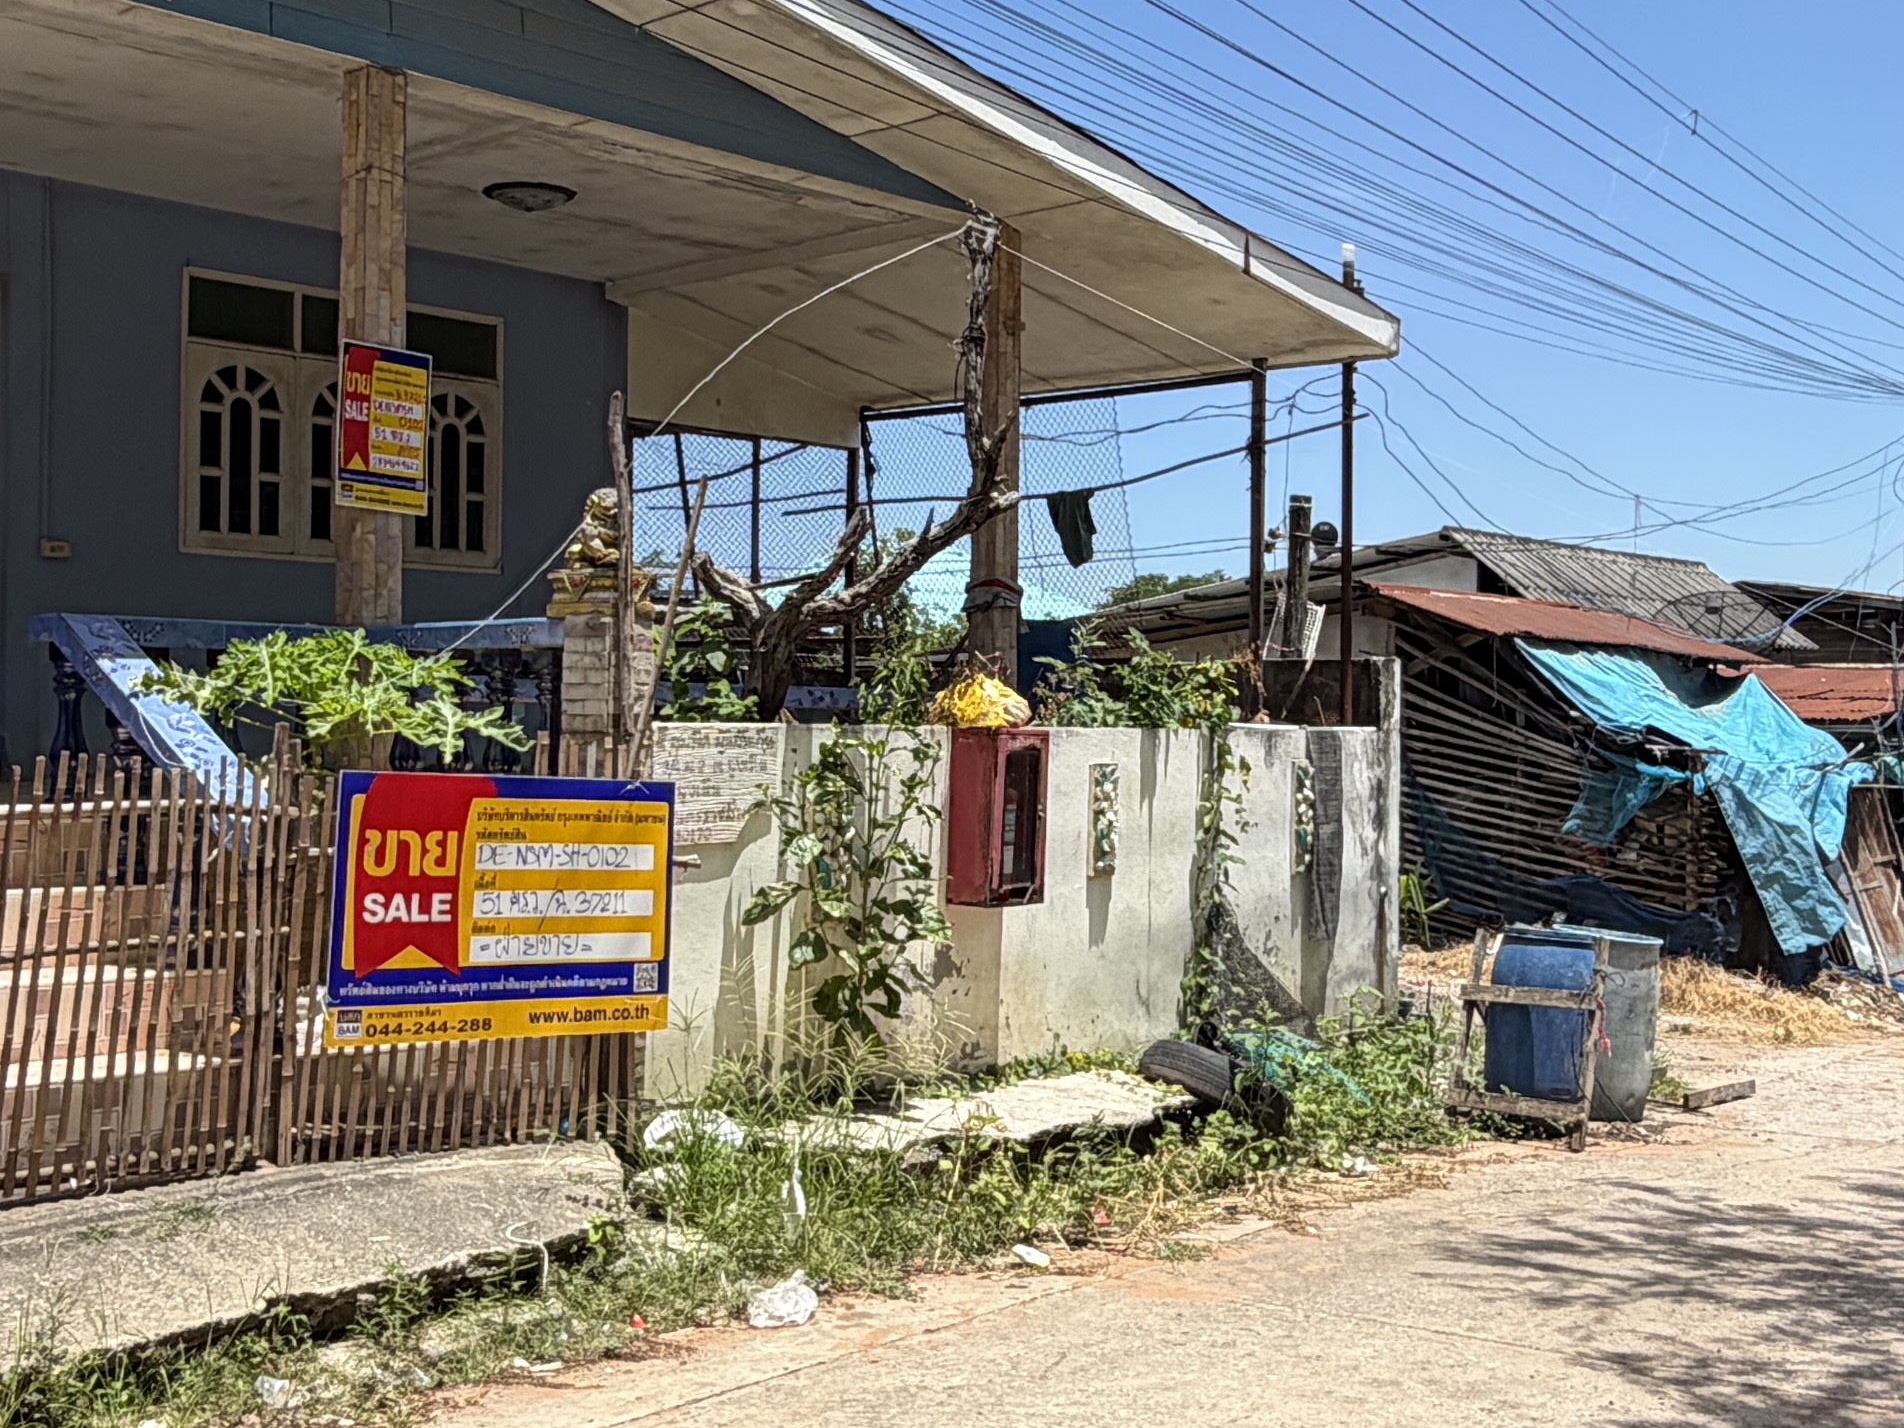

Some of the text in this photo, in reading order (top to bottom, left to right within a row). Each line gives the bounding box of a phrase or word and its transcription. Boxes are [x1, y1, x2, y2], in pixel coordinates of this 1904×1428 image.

[346, 371, 371, 395] ขาย
[345, 399, 369, 422] SALE
[363, 829, 458, 877] ขาย
[362, 892, 453, 923] SALE
[529, 1004, 650, 1024] www.bam.co.th
[365, 1018, 493, 1038] 044-244-288
